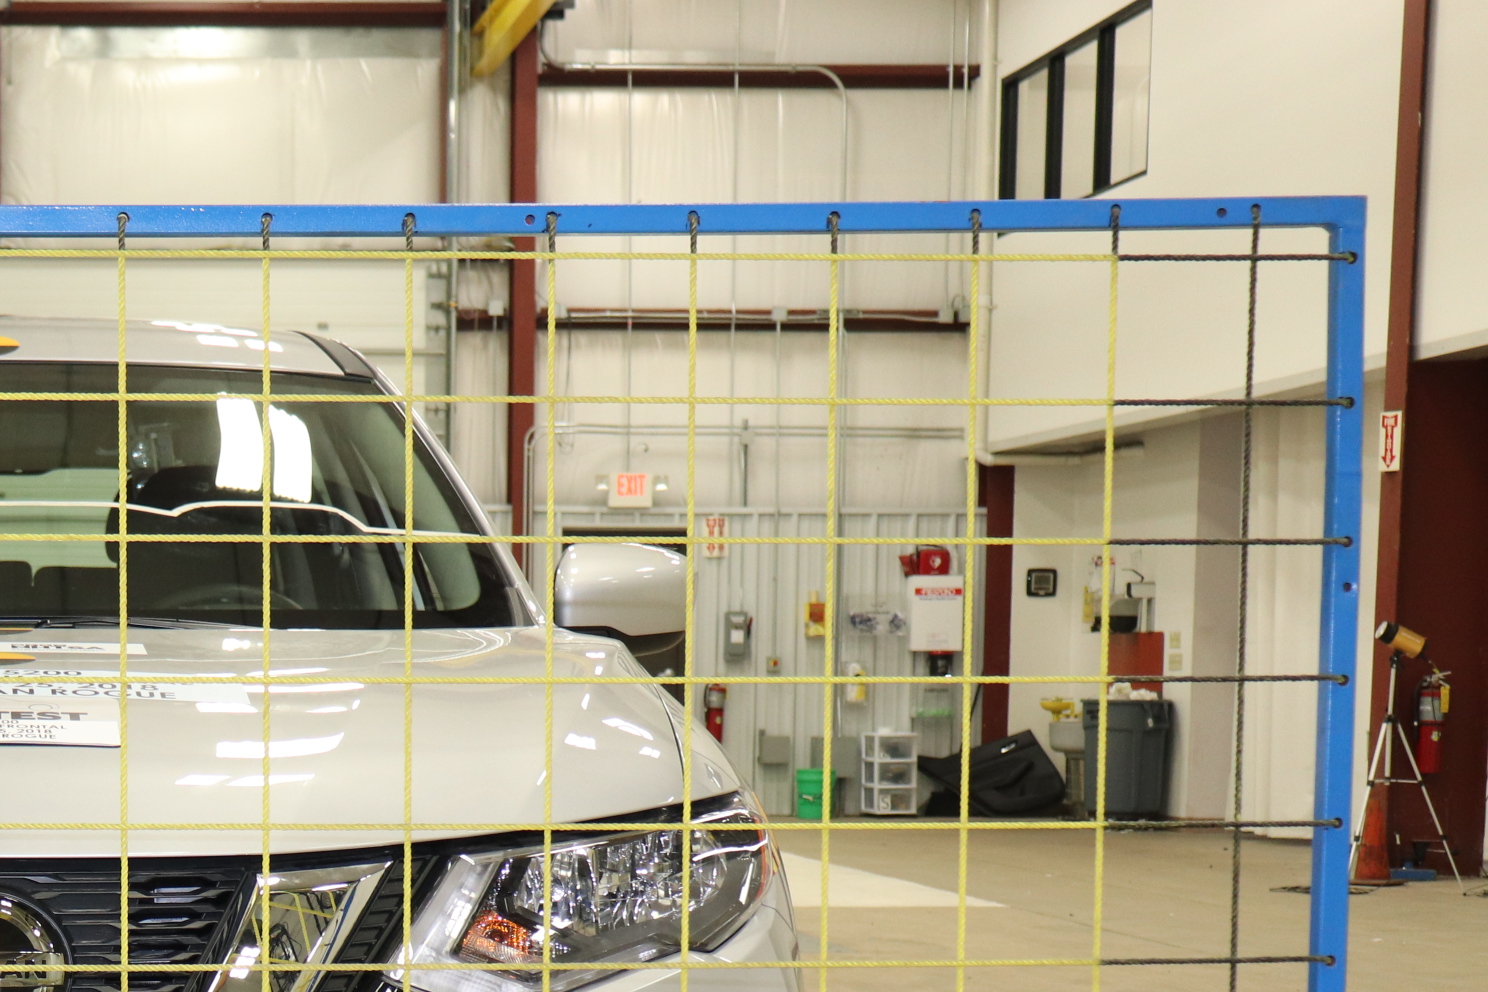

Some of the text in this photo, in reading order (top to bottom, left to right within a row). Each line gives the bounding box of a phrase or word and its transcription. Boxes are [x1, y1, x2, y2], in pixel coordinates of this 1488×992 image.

[617, 473, 647, 497] EXIT
[78, 682, 159, 691] 2018
[50, 688, 177, 699] ROGUE
